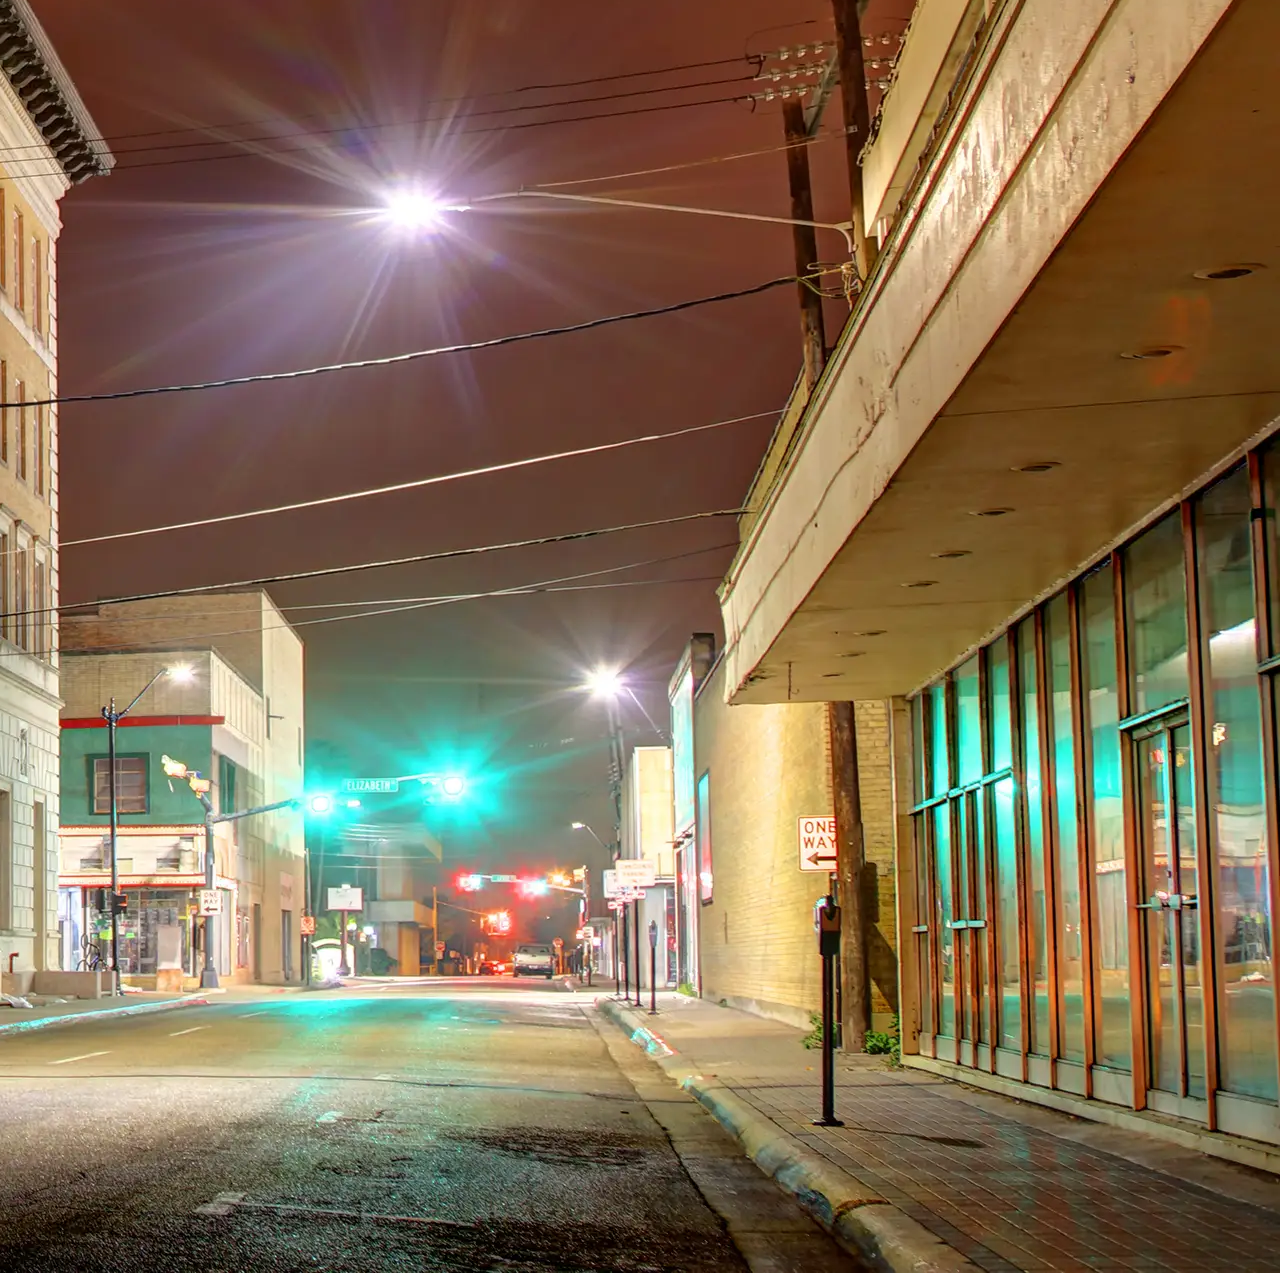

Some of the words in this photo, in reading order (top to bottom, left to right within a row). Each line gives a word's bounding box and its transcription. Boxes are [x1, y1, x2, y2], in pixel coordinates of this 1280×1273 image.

[347, 780, 391, 791] ELIZABETH
[804, 821, 837, 834] ONE
[803, 836, 837, 849] WAY
